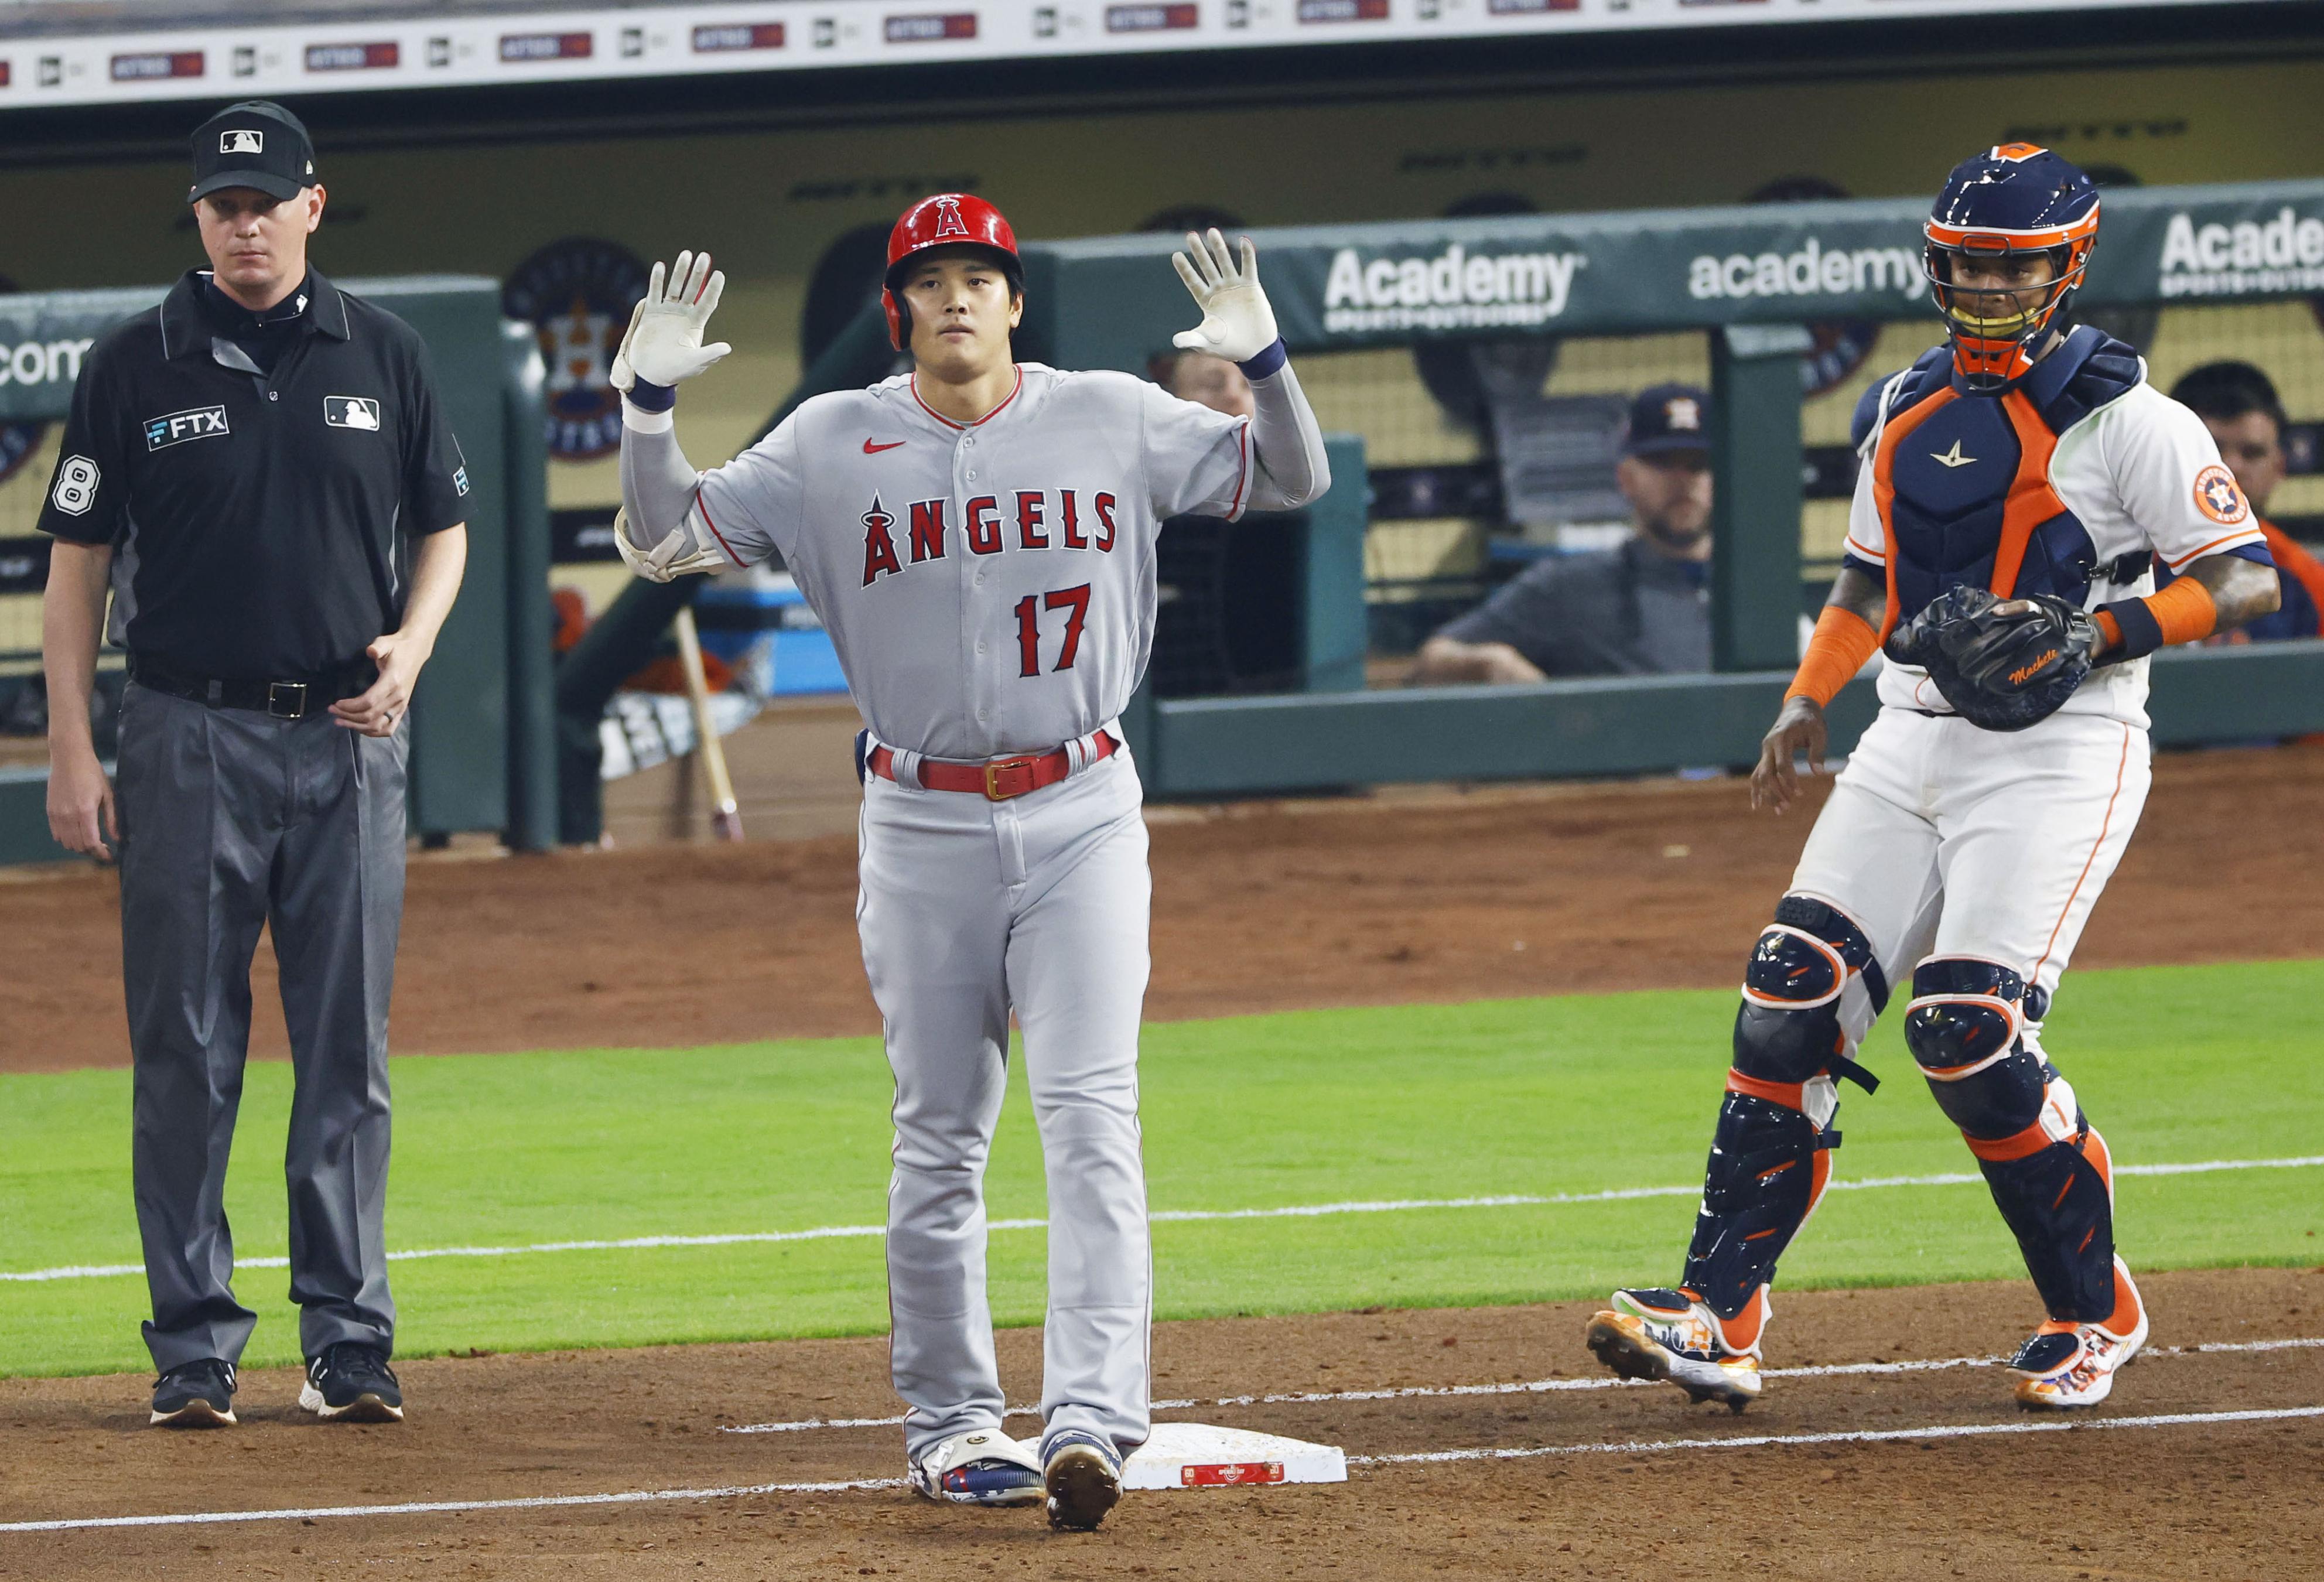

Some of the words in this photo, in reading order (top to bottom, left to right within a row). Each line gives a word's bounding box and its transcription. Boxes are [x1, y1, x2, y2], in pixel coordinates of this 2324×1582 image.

[935, 196, 969, 237] A
[1324, 244, 1575, 317] Academy
[170, 411, 225, 439] FTX
[52, 454, 101, 516] 8
[861, 488, 1116, 589] ANGELS
[1015, 583, 1091, 678] 17
